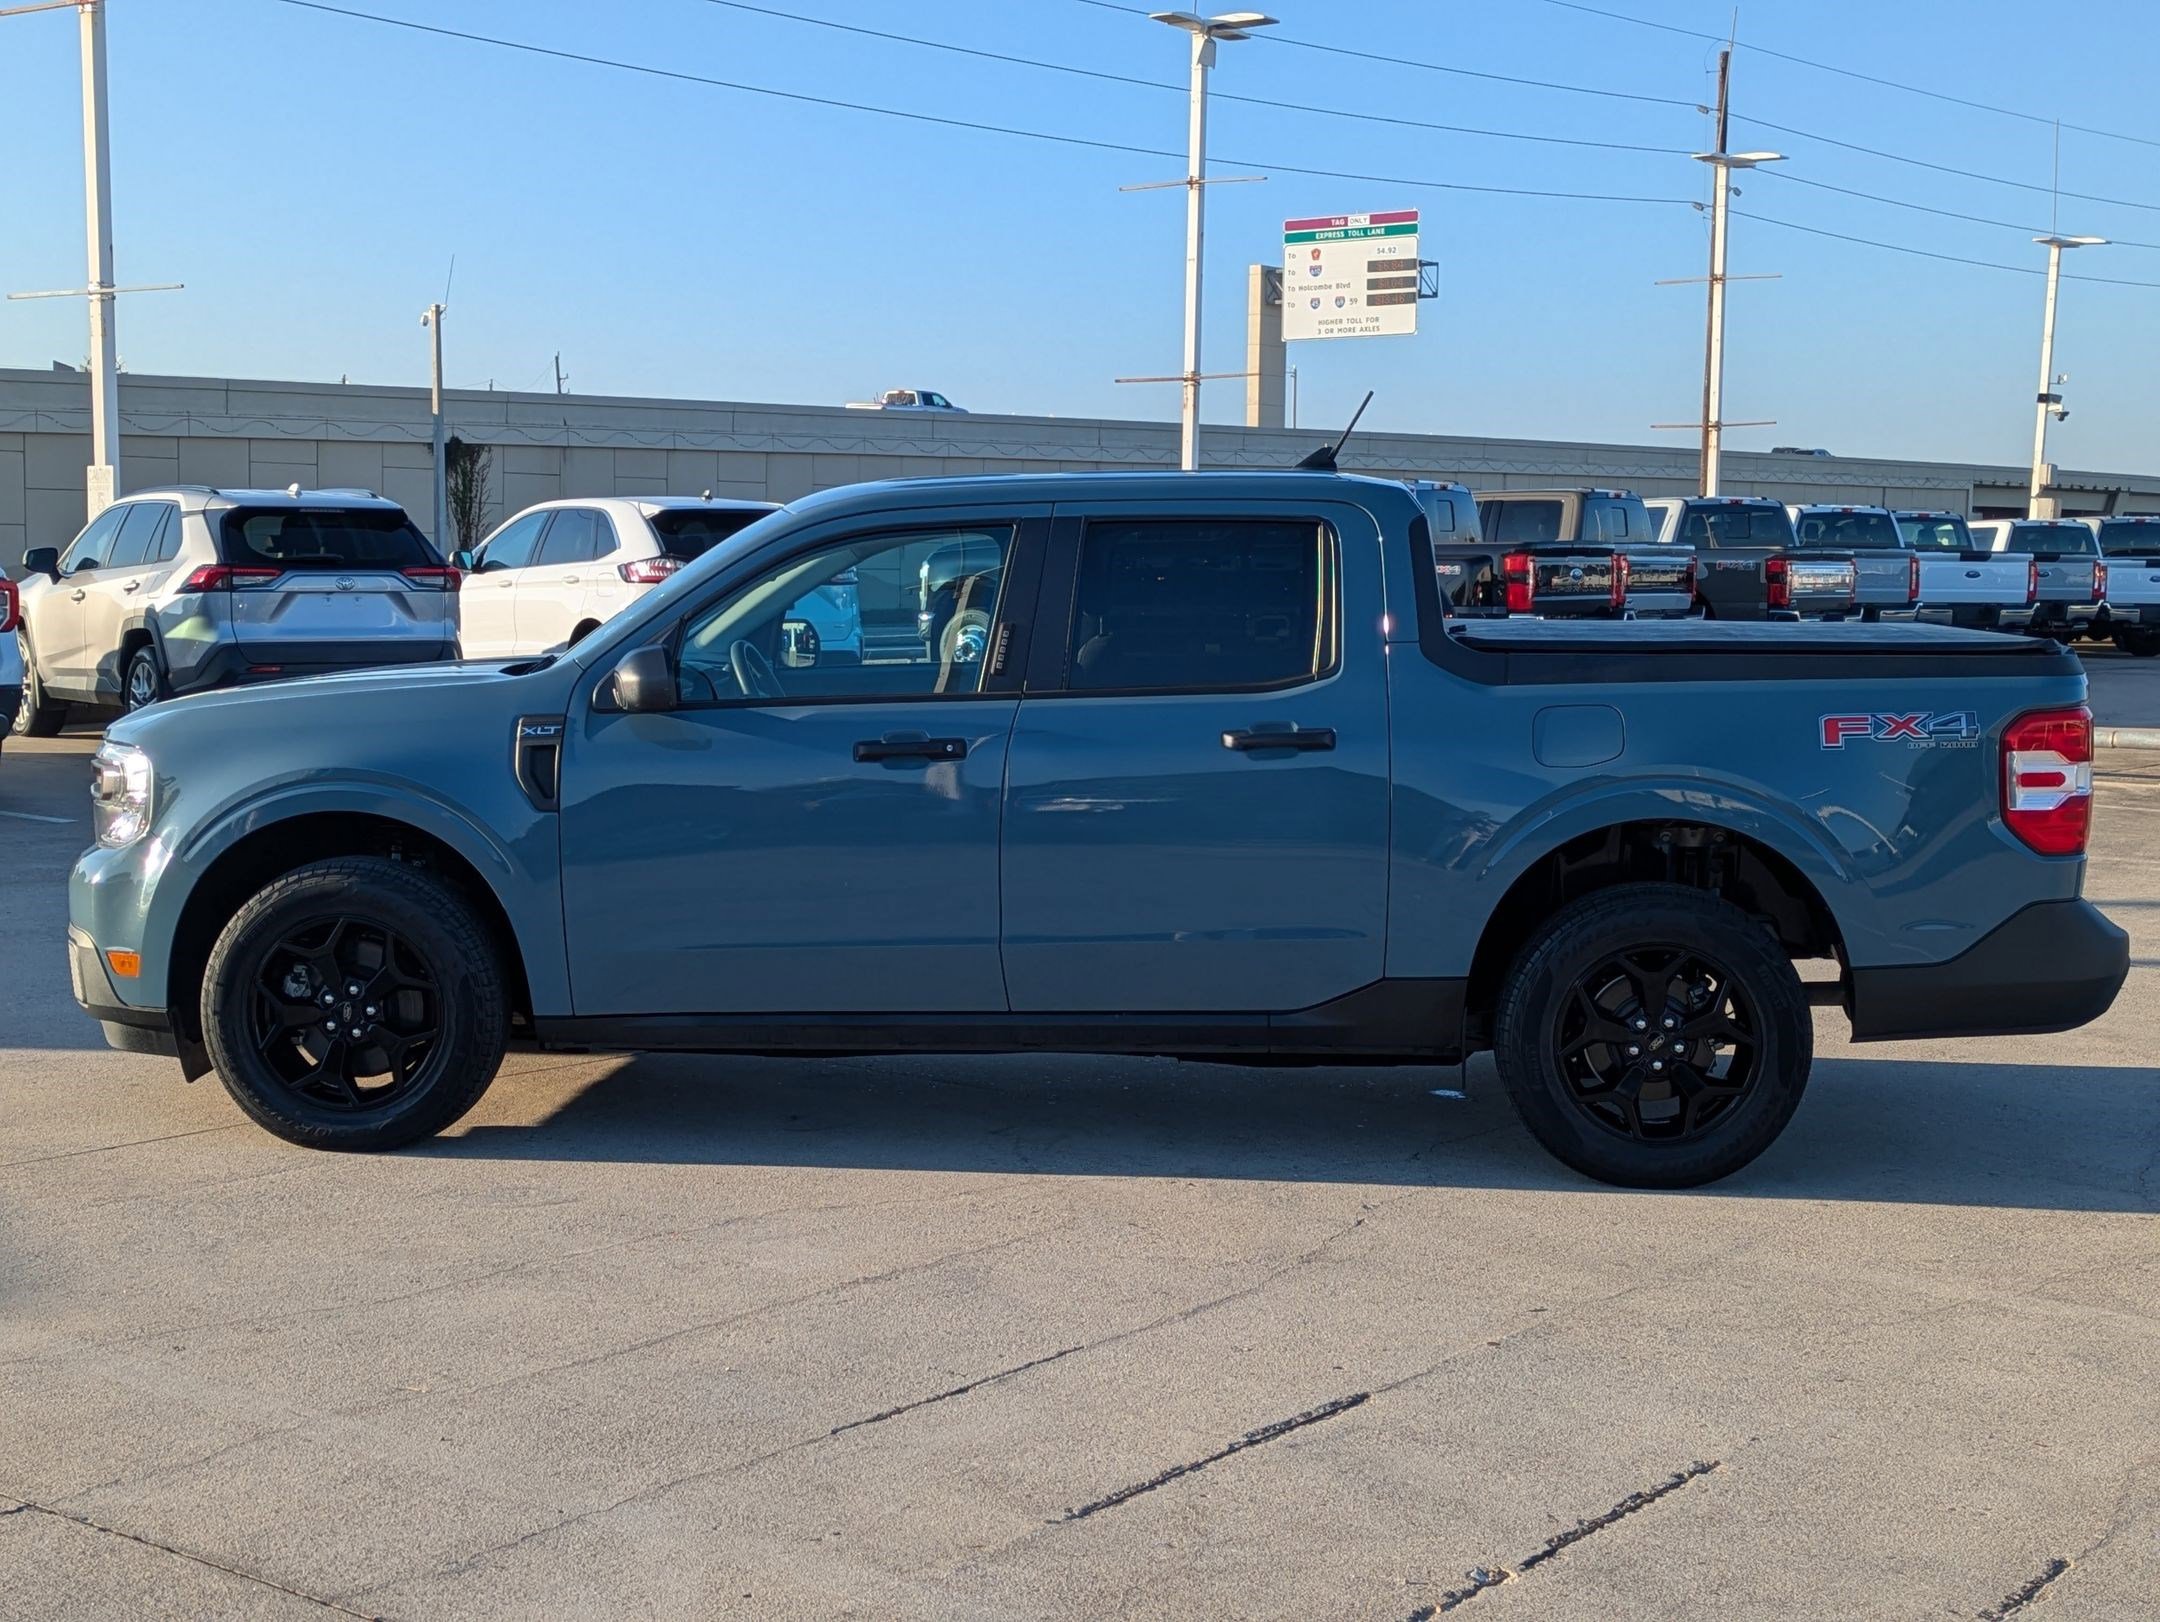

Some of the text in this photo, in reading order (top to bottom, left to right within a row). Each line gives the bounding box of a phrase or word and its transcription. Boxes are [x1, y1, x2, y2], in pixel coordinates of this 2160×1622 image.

[1331, 216, 1367, 226] TAG ONLY
[1316, 228, 1385, 240] EXPRESS TOLL LANE
[520, 726, 562, 735] XLT
[1818, 711, 1981, 750] FX4
